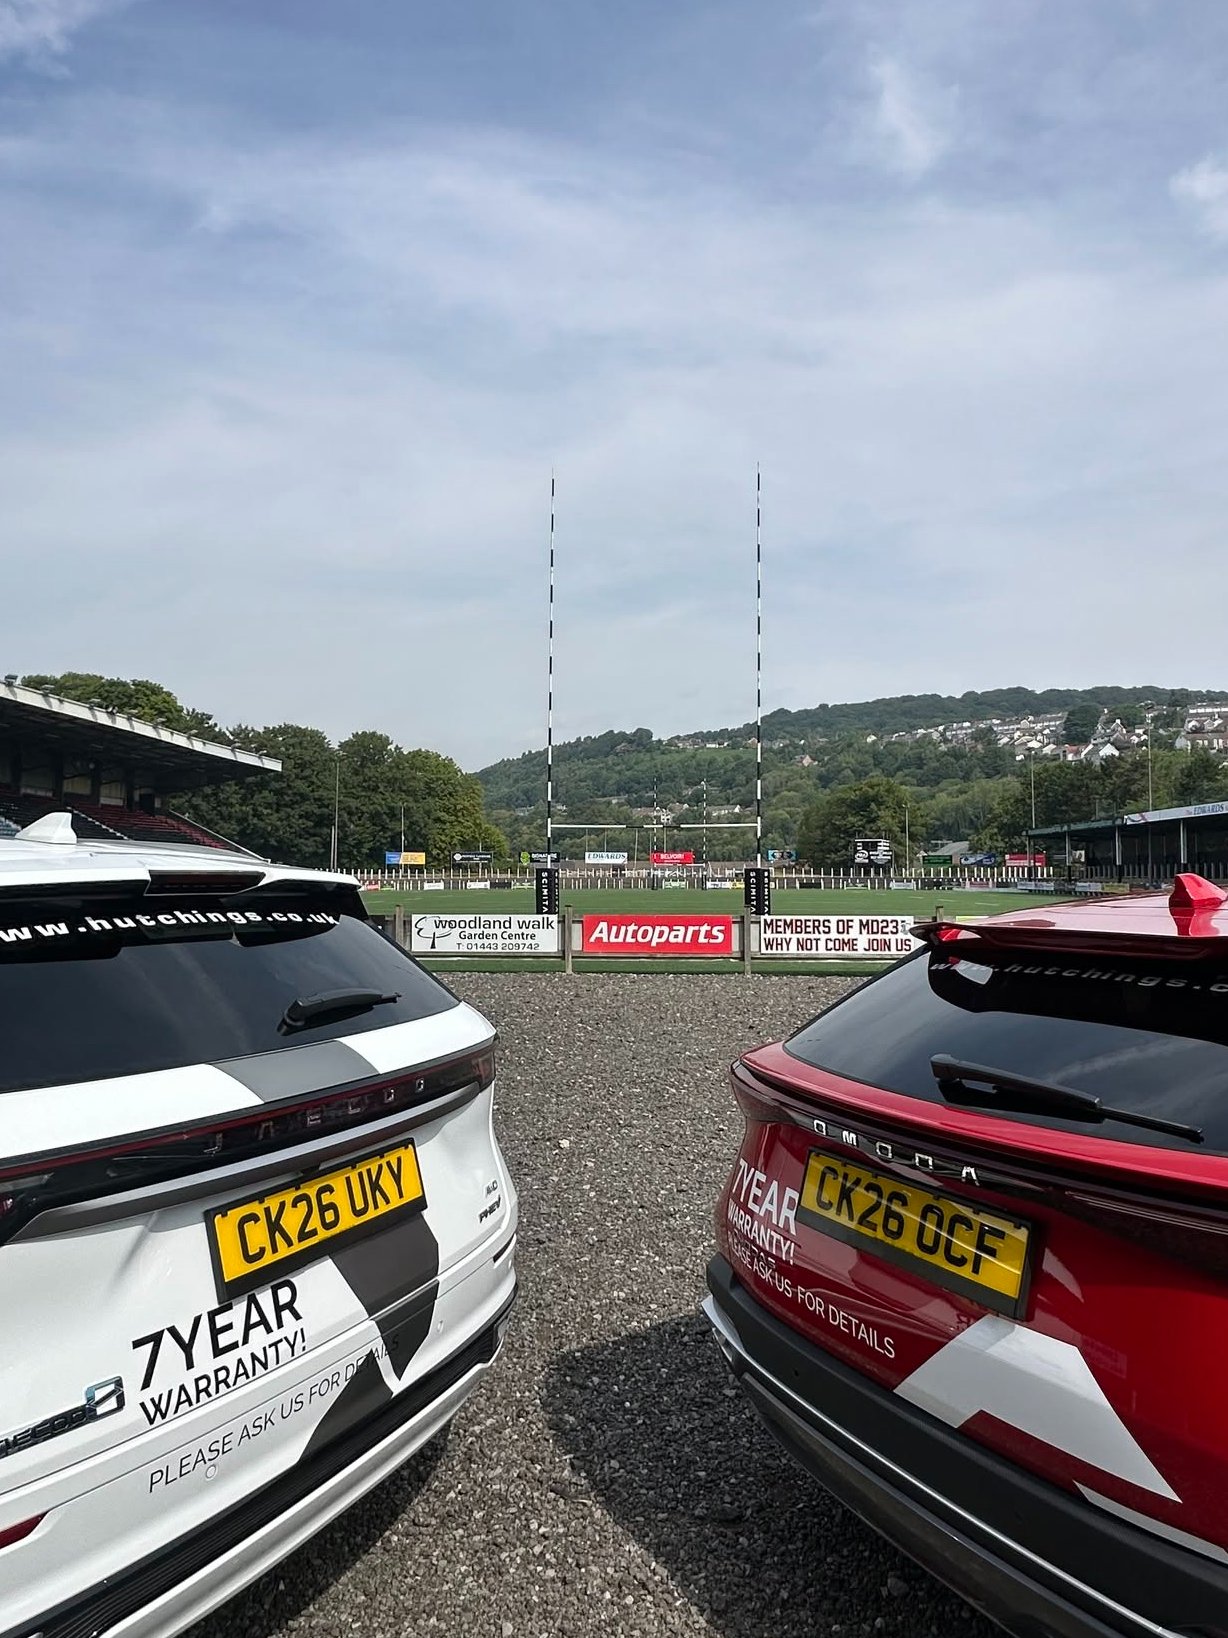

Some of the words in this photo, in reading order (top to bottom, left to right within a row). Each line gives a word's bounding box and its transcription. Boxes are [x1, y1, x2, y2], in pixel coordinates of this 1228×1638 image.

[587, 852, 626, 860] EDWARDS
[434, 916, 512, 930] woodland
[517, 916, 555, 930] walk
[458, 931, 498, 941] Garden
[500, 931, 536, 941] Centre
[466, 942, 499, 951] 01443
[501, 942, 540, 951] 209742
[589, 921, 725, 947] Autoparts
[763, 918, 831, 935] MEMBERS
[836, 919, 854, 935] OF
[859, 919, 899, 935] MD23
[763, 937, 793, 952] WHY
[796, 937, 821, 952] NOT
[825, 938, 859, 952] COME
[863, 938, 891, 952] JOIN
[895, 938, 912, 952] US
[814, 1120, 980, 1186] OMODA
[237, 1183, 341, 1264] CK26
[345, 1156, 404, 1218] UKY
[732, 1157, 799, 1236] 7YEAR
[816, 1165, 909, 1241] CK26
[916, 1203, 1006, 1275] OCF
[728, 1198, 795, 1266] WARRANTY!
[132, 1279, 302, 1391] 7YEAR
[753, 1257, 774, 1287] ASK
[775, 1271, 793, 1298] US
[797, 1285, 825, 1319] FOR
[829, 1304, 895, 1358] DETAILS
[139, 1327, 307, 1425] WARRANTY!
[149, 1431, 234, 1493] PLEASE
[237, 1408, 276, 1448] ASK
[280, 1392, 304, 1420] US
[308, 1371, 341, 1406] FOR
